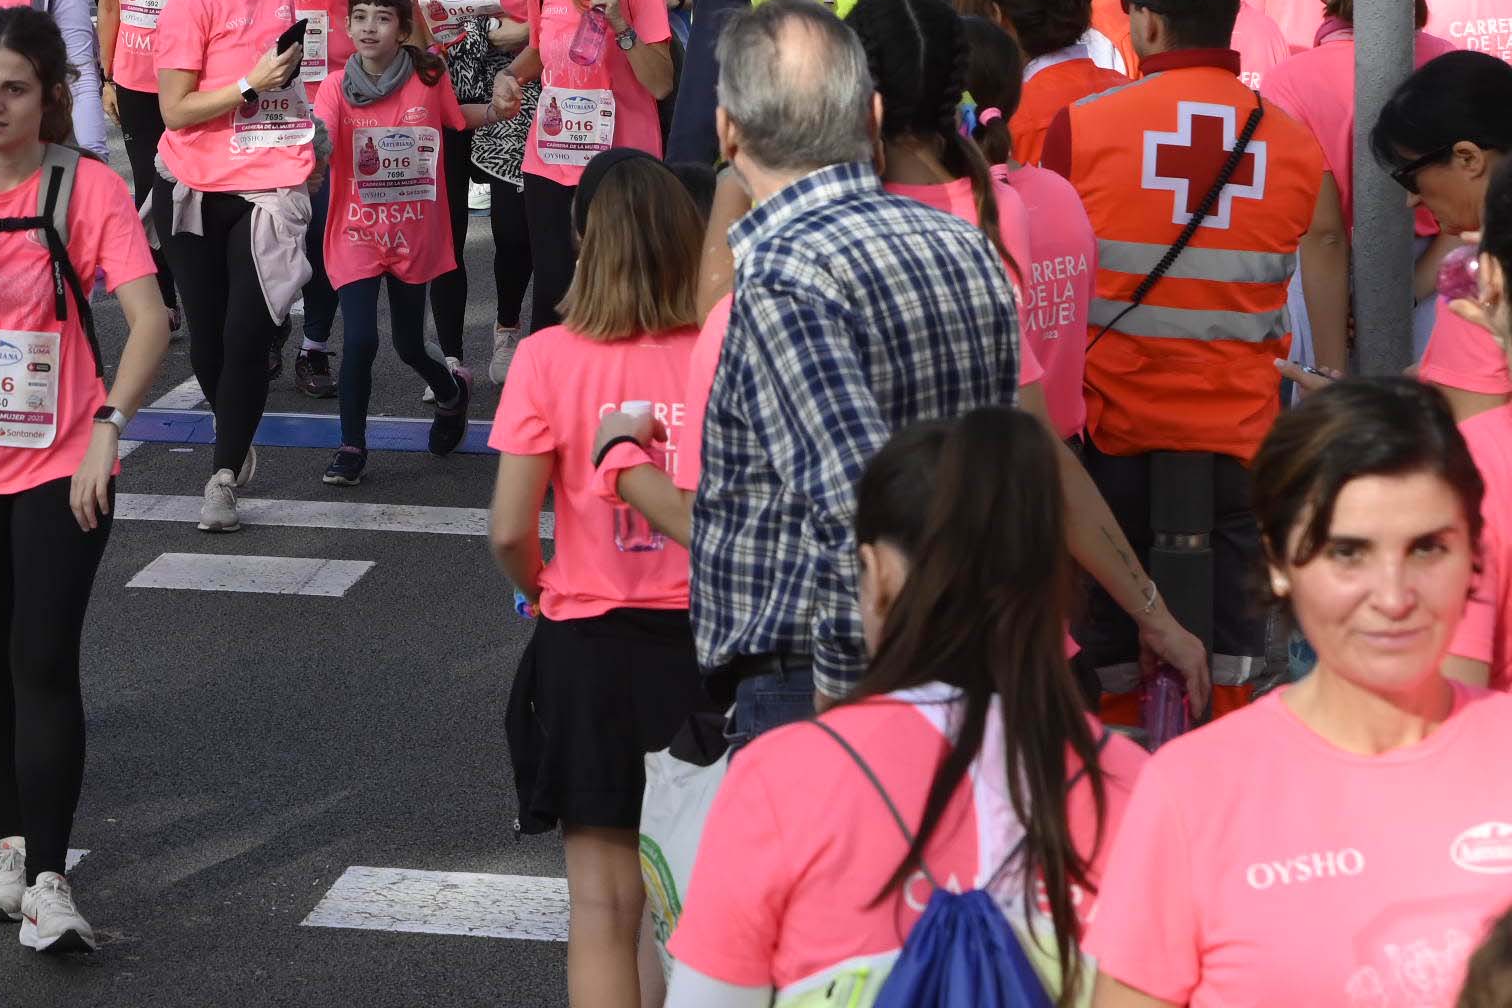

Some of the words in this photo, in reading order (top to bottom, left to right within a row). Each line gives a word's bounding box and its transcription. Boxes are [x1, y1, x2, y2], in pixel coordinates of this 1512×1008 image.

[449, 5, 475, 17] 016
[1467, 35, 1490, 51] DE
[261, 99, 289, 110] 016
[344, 117, 377, 127] OYSHO
[564, 120, 593, 131] 016
[379, 140, 414, 149] ASTURIANA
[382, 156, 411, 169] 016
[544, 152, 570, 161] OYSHO
[348, 202, 424, 225] DORSAL
[1053, 281, 1075, 302] LA
[0, 413, 26, 422] MUJER
[6, 428, 45, 440] Santander
[1246, 847, 1366, 890] OYSHO
